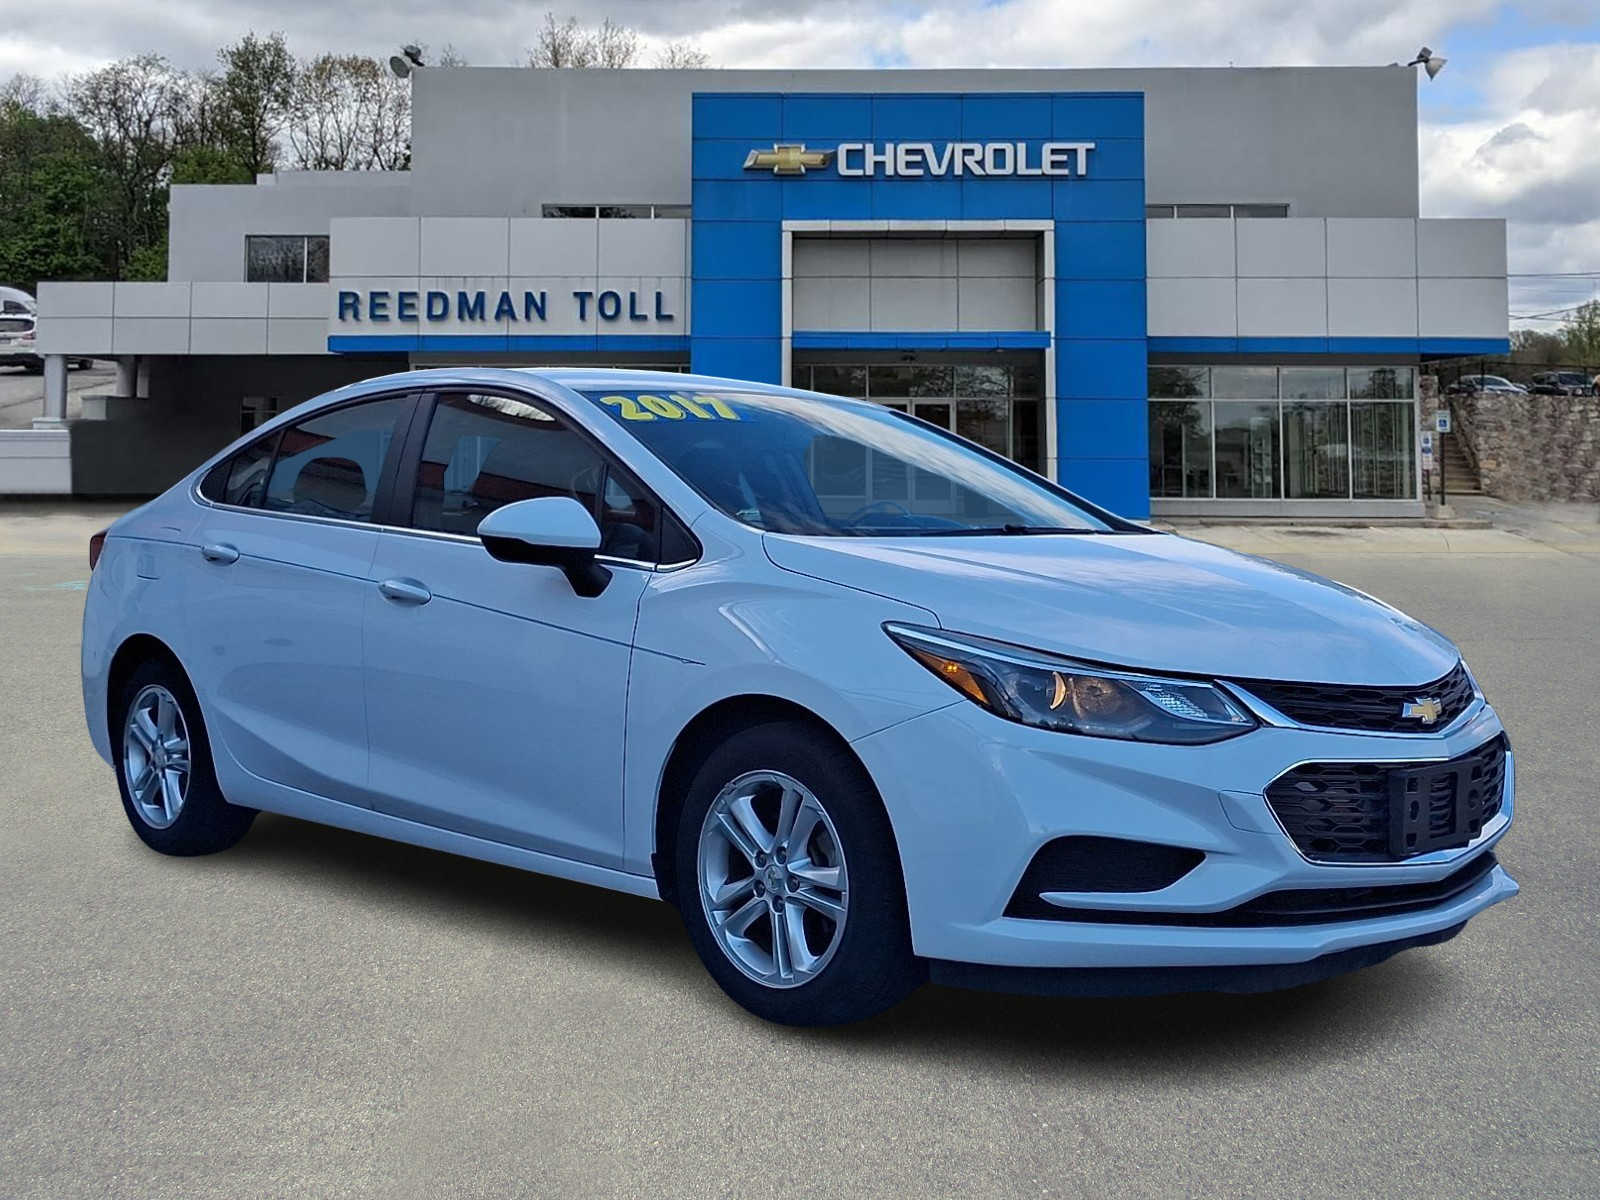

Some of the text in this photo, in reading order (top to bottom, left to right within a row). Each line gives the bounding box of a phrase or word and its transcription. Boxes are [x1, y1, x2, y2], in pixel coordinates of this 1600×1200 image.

[836, 142, 1096, 177] CHEVROLET
[338, 290, 674, 321] REEDMAN TOLL
[600, 394, 741, 421] 2017
